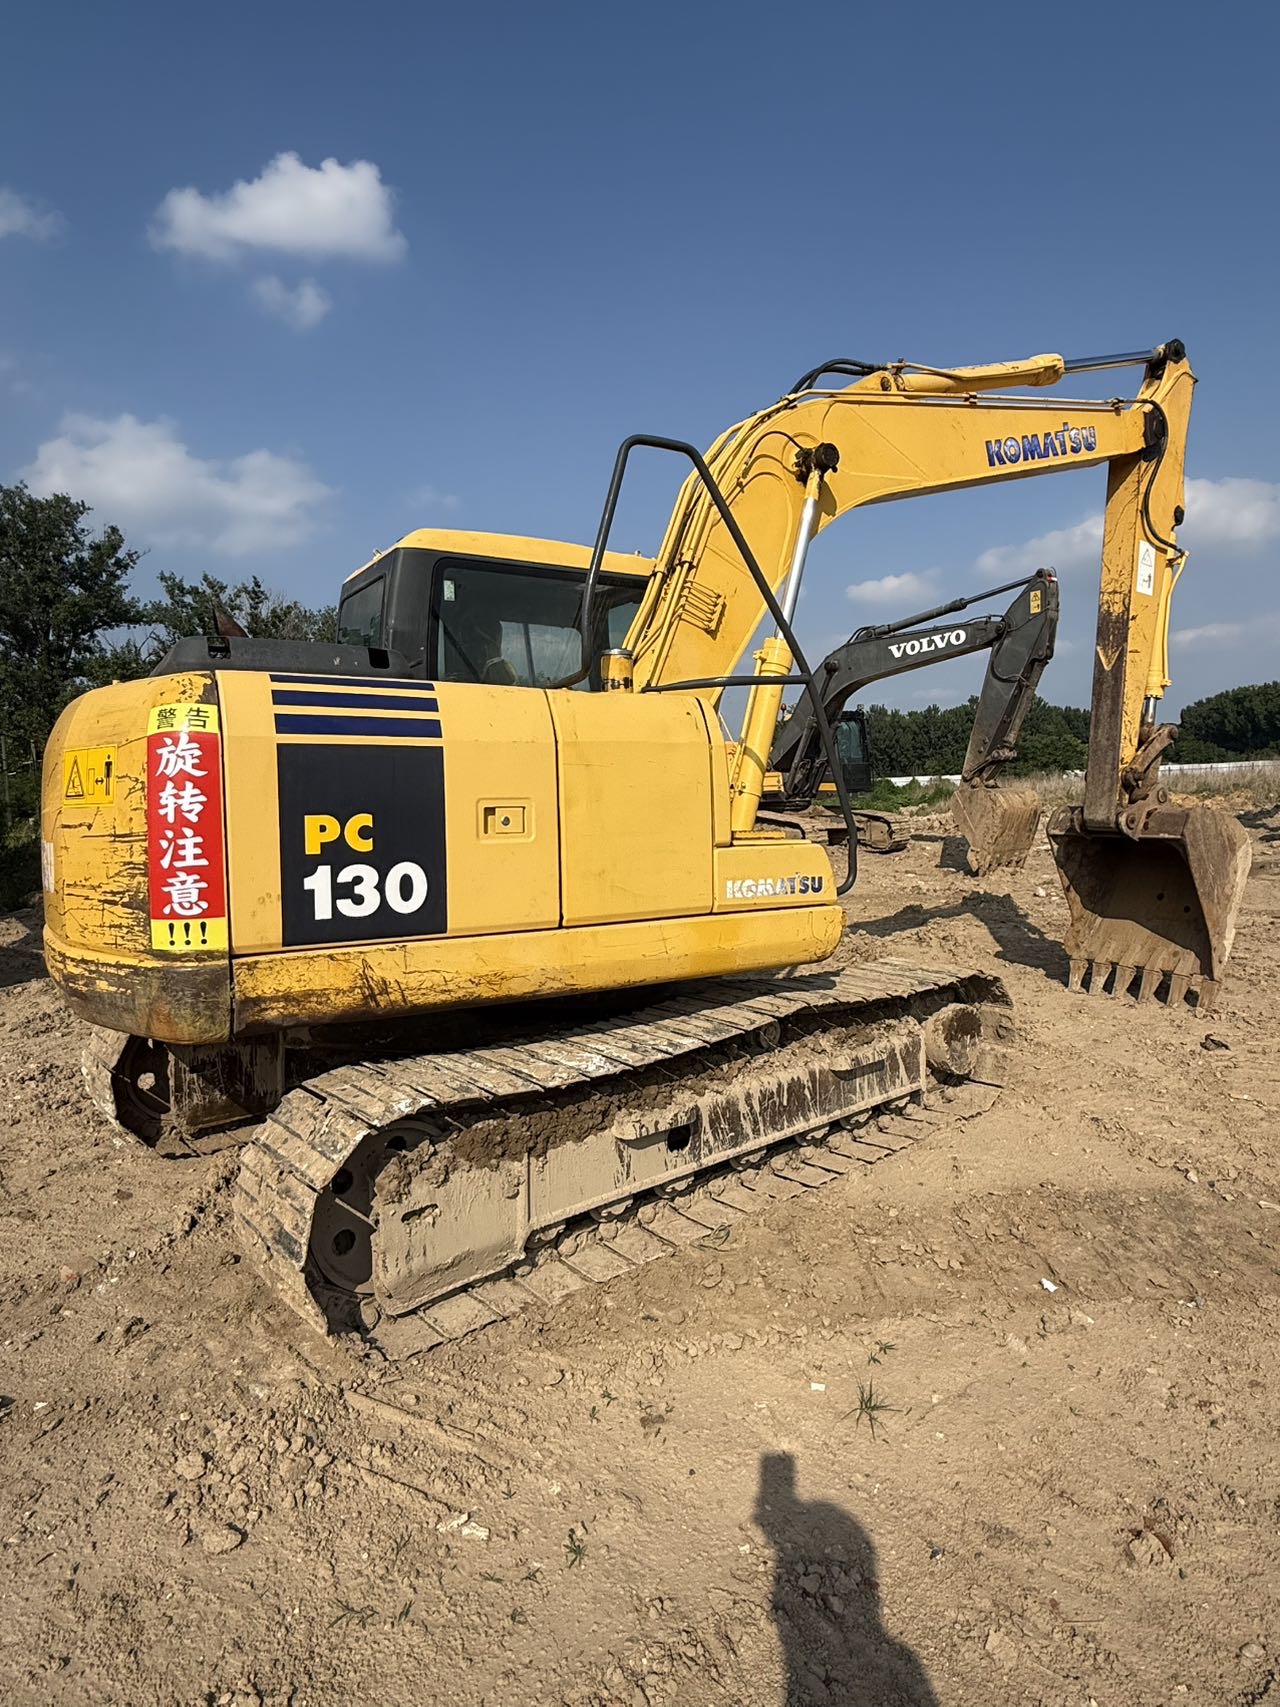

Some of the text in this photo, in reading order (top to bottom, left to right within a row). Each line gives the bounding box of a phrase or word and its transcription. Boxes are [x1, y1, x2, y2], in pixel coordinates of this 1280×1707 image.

[985, 422, 1097, 467] KOMATSU
[888, 629, 967, 659] VOLVO
[156, 706, 210, 730] 警告
[154, 735, 209, 917] 旋转注意
[303, 813, 374, 856] PC
[303, 862, 428, 921] 130
[726, 873, 823, 899] KOMATSU
